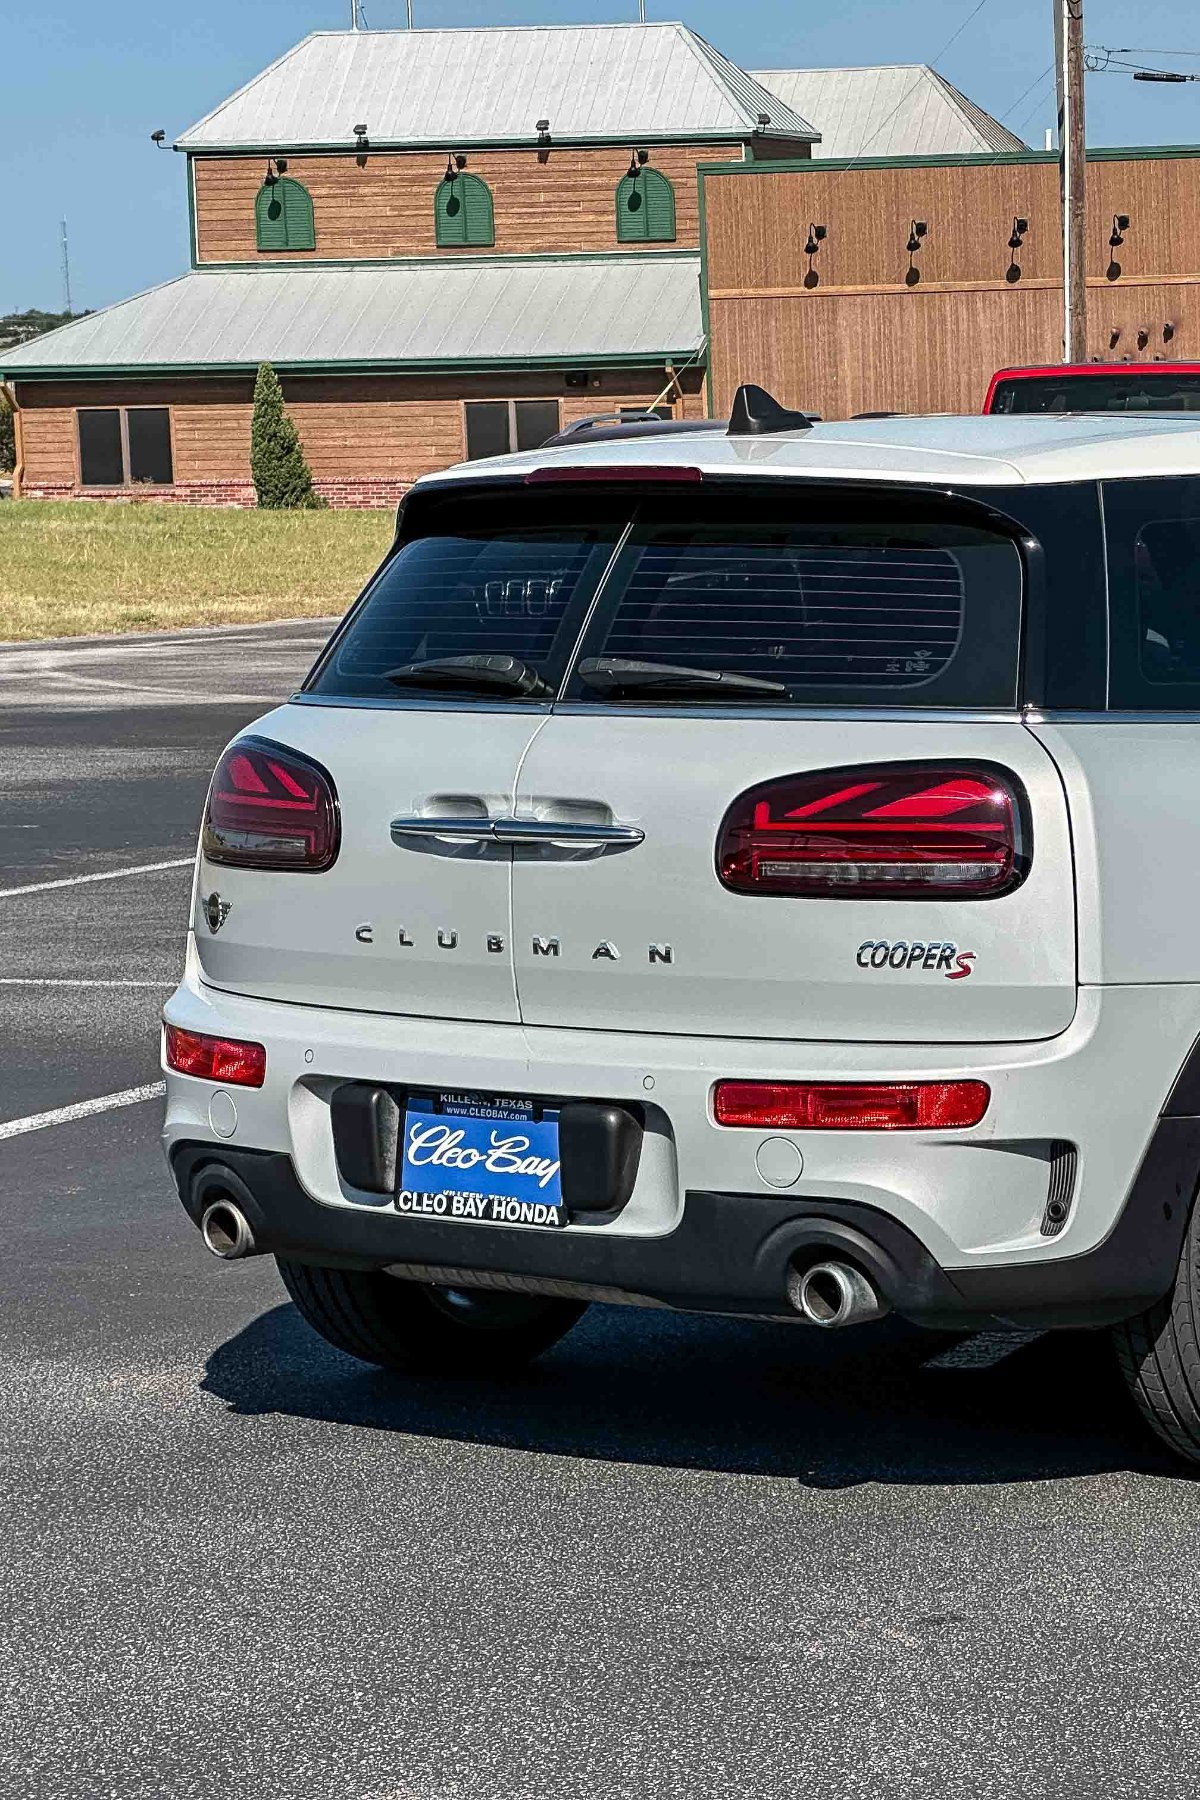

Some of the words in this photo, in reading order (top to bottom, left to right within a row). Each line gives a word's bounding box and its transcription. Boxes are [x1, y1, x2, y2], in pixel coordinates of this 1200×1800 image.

[354, 923, 674, 964] CLUBMAN
[445, 1106, 529, 1121] www.CLEOBAY.com
[493, 1097, 533, 1109] TEXAS
[407, 1122, 488, 1169] Cleo
[484, 1129, 561, 1189] Bay
[398, 1190, 448, 1215] CLEO
[452, 1195, 489, 1219] BAY
[492, 1199, 560, 1226] HONDA
